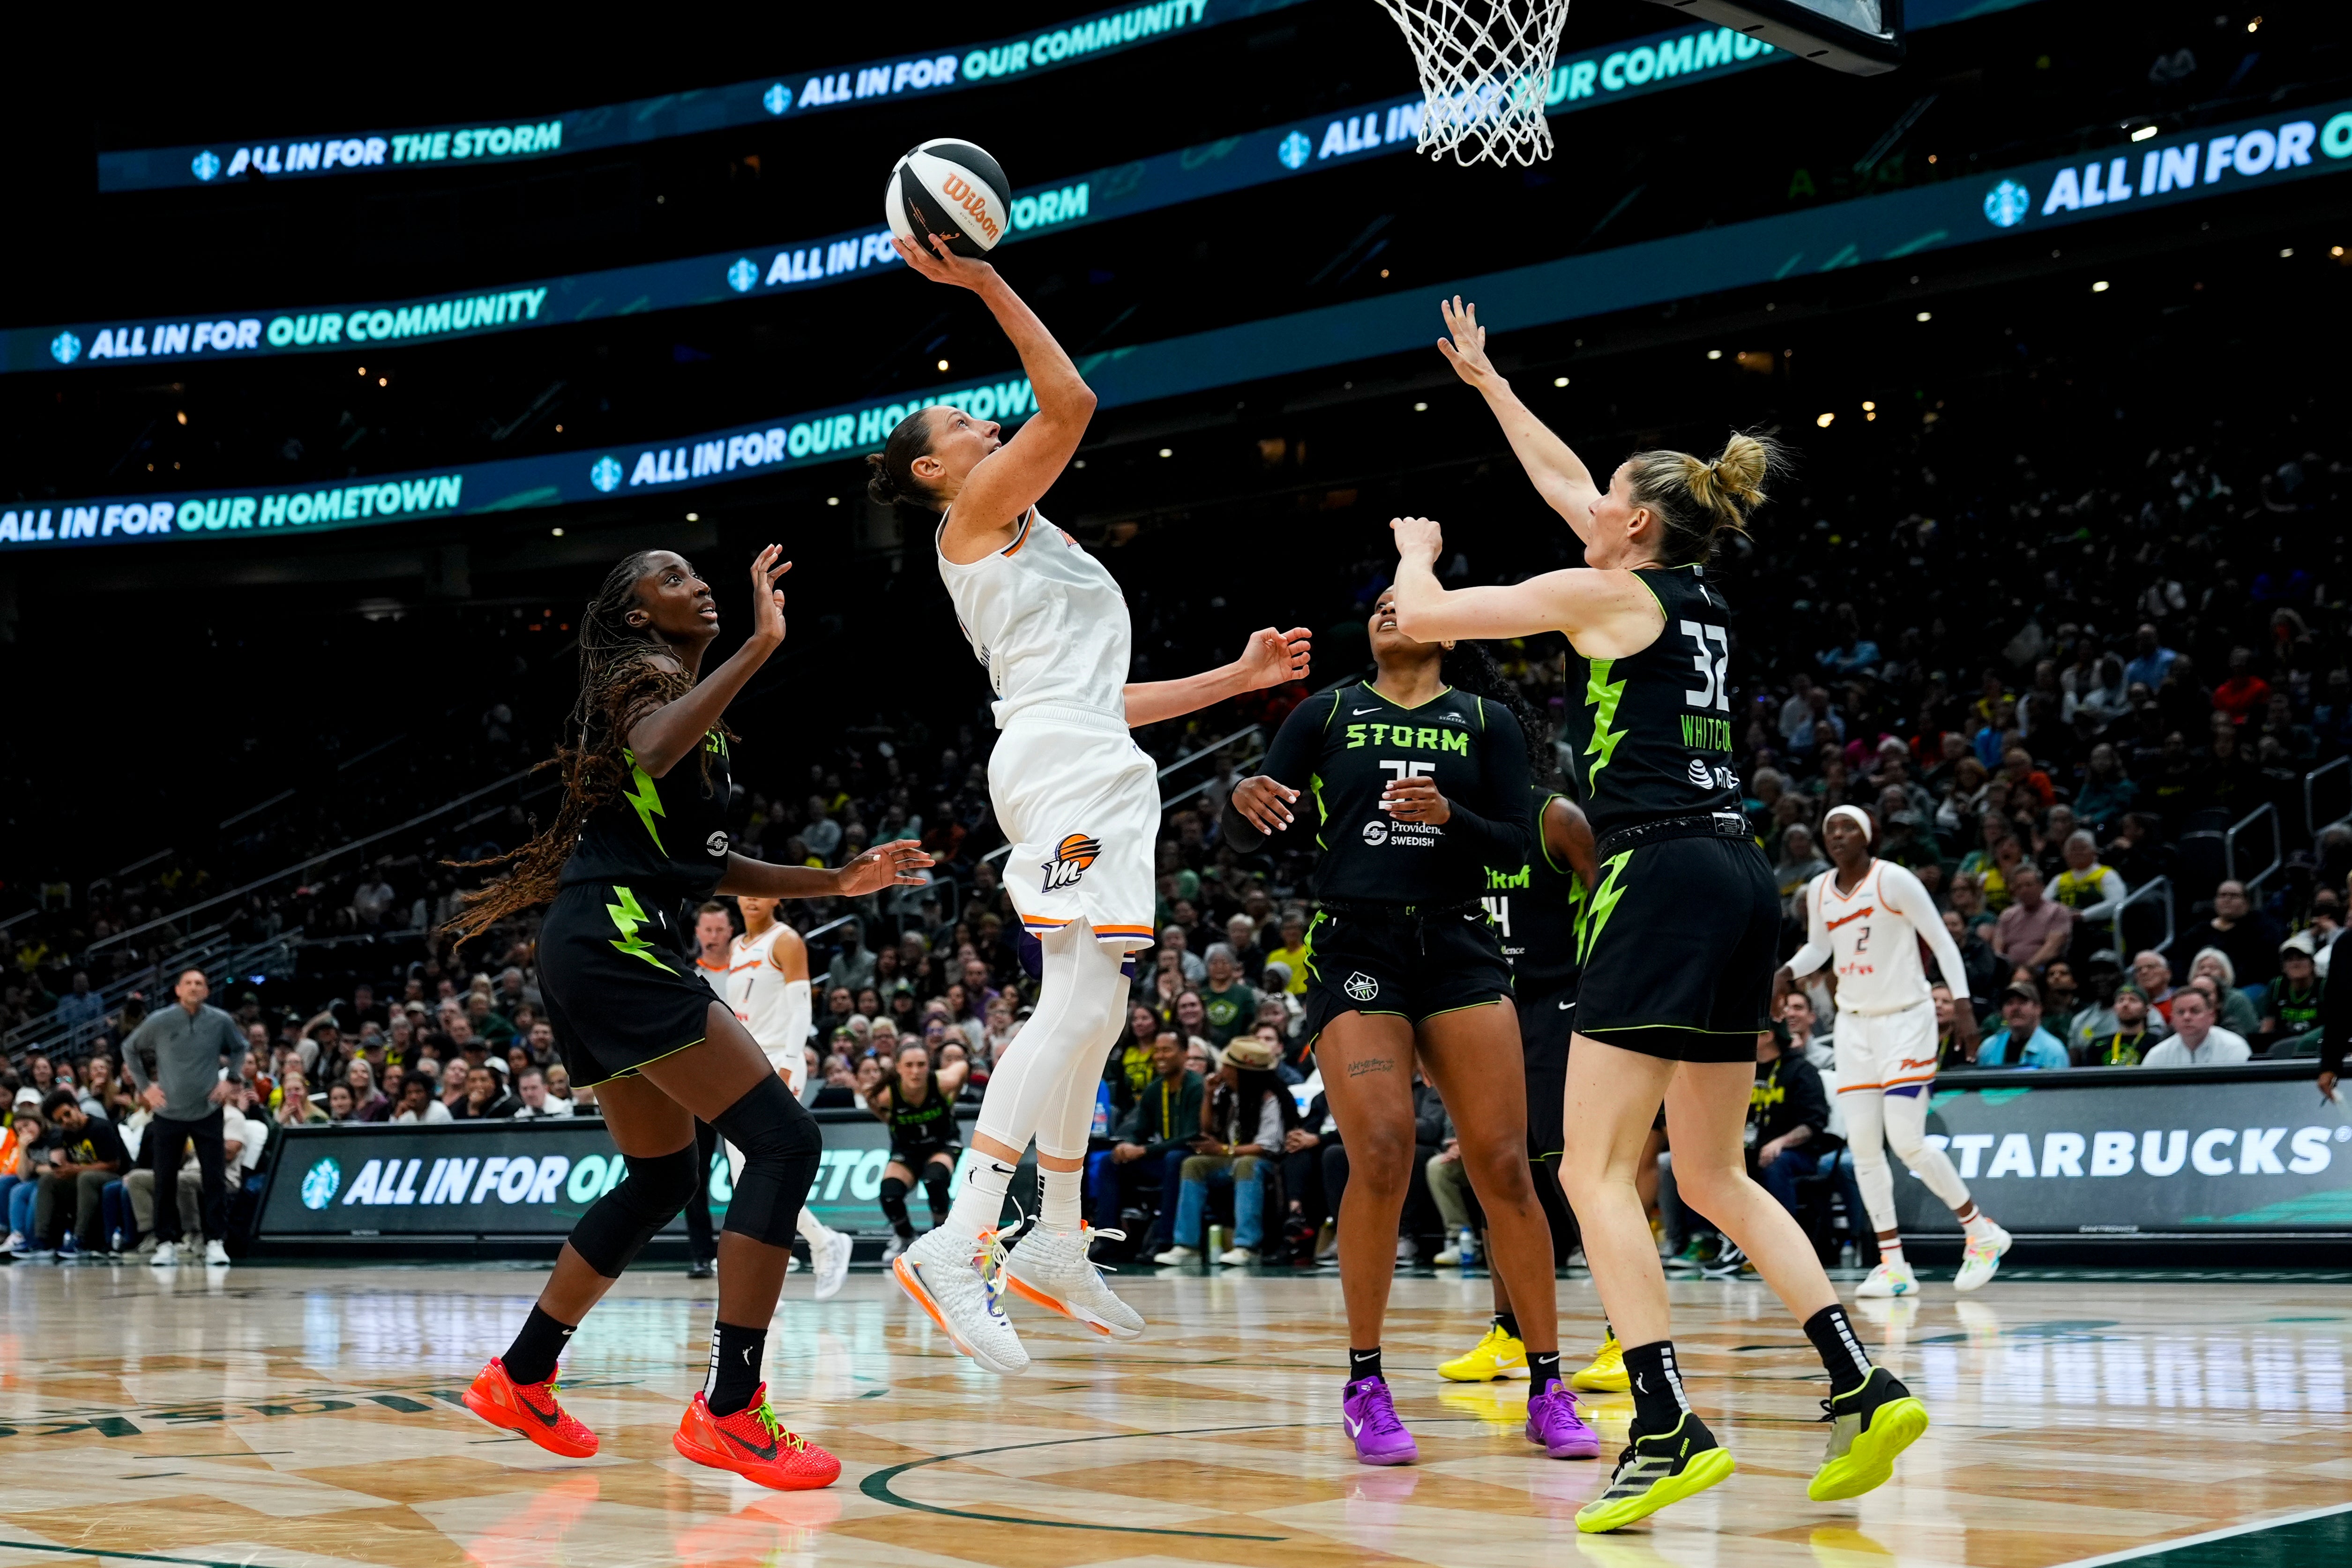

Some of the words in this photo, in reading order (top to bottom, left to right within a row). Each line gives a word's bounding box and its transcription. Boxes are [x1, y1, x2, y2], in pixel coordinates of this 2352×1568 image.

[798, 73, 852, 108] ALL
[855, 66, 891, 98] IN
[892, 55, 958, 92] FOR
[962, 41, 1030, 80] OUR
[1031, 0, 1208, 65] COMMUNITY
[1319, 113, 1381, 159] ALL
[1384, 100, 1426, 143] IN
[1513, 61, 1597, 110] OUR
[1601, 27, 1775, 91] COMMU
[227, 146, 281, 176] ALL
[285, 142, 321, 171] IN
[322, 137, 387, 168] FOR
[391, 133, 451, 163] THE
[451, 121, 562, 158] STORM
[2042, 158, 2132, 215] ALL
[2140, 143, 2198, 196] IN
[2204, 122, 2315, 183] FOR
[766, 248, 823, 285] ALL
[826, 239, 859, 275] IN
[859, 229, 904, 268] FO
[1006, 183, 1089, 234] TORM
[943, 172, 999, 242] Wilson
[89, 327, 147, 359] ALL
[151, 324, 190, 354] IN
[192, 319, 261, 352] FOR
[267, 313, 343, 346] OUR
[345, 288, 546, 341] COMMUNITY
[630, 448, 689, 485] ALL
[692, 440, 724, 477] IN
[726, 428, 787, 470] FOR
[788, 414, 856, 457] OUR
[0, 509, 54, 542] ALL
[59, 506, 99, 538] IN
[102, 502, 174, 536] FOR
[177, 497, 257, 531] OUR
[259, 475, 462, 527] HOMETOWN
[1680, 620, 1730, 712] 32
[1346, 724, 1470, 757] STORM
[1391, 821, 1446, 836] Providen
[1391, 836, 1434, 847] SWEDISH
[1853, 926, 1871, 955] 2
[744, 977, 754, 1003] 1
[342, 1159, 422, 1205] ALL
[419, 1157, 479, 1204] IN
[470, 1156, 570, 1204] FOR
